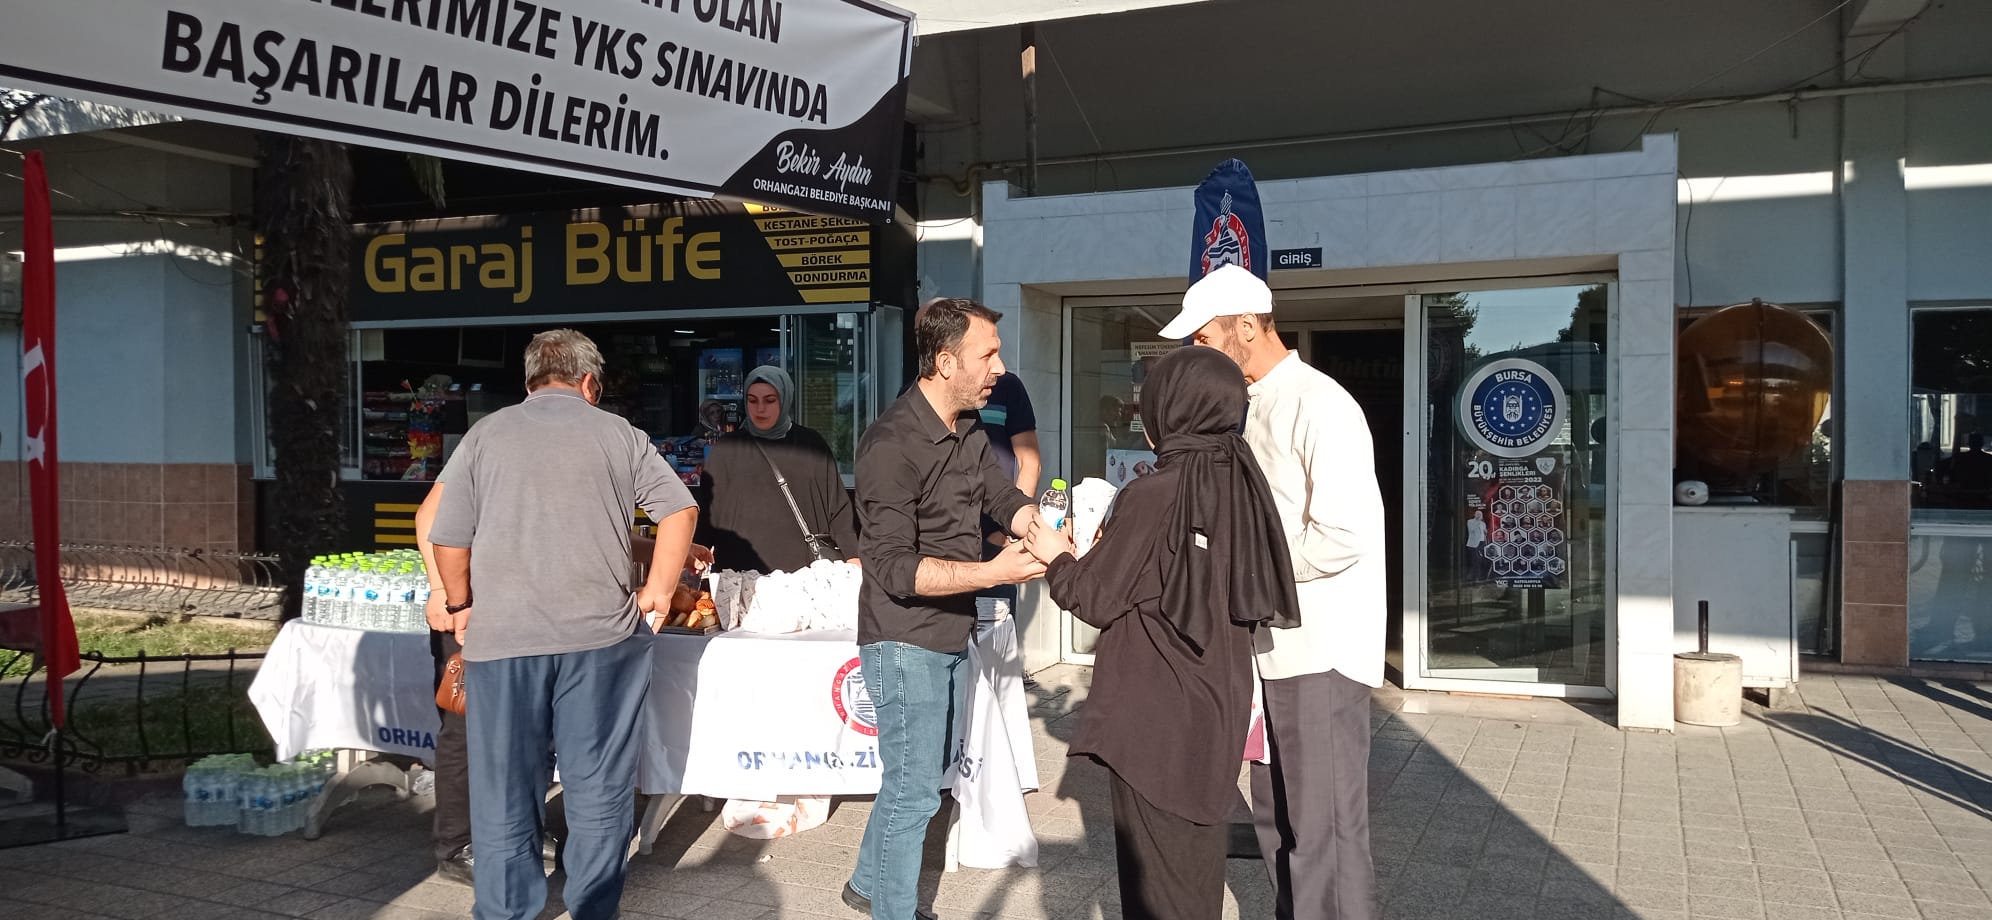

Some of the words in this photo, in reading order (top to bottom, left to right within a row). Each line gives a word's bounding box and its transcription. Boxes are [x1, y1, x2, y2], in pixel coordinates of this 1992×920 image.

[572, 16, 647, 80] YKS
[651, 41, 828, 124] SINAVINDA
[162, 10, 478, 125] BAŞARILAR
[489, 73, 669, 161] DİLERİM.
[776, 140, 820, 176] Bekir
[823, 152, 872, 192] Aydın
[753, 178, 809, 198] ORHANGAZİ
[849, 195, 891, 211] BAŞKANI
[764, 218, 818, 231] KESTANE
[774, 233, 859, 247] TOST-POĞAÇA
[364, 225, 533, 304] Garaj
[565, 216, 721, 286] Büfe
[801, 253, 842, 265] BÖREK
[1279, 251, 1312, 266] GİRİŞ
[794, 270, 867, 283] DONDURMA
[1495, 370, 1532, 383] BURSA
[1473, 404, 1514, 447] BÜYÜKŞEHİR
[1516, 404, 1553, 446] BELEDİYESİ
[378, 726, 437, 750] ORHA
[737, 745, 877, 770] ORANGZİ
